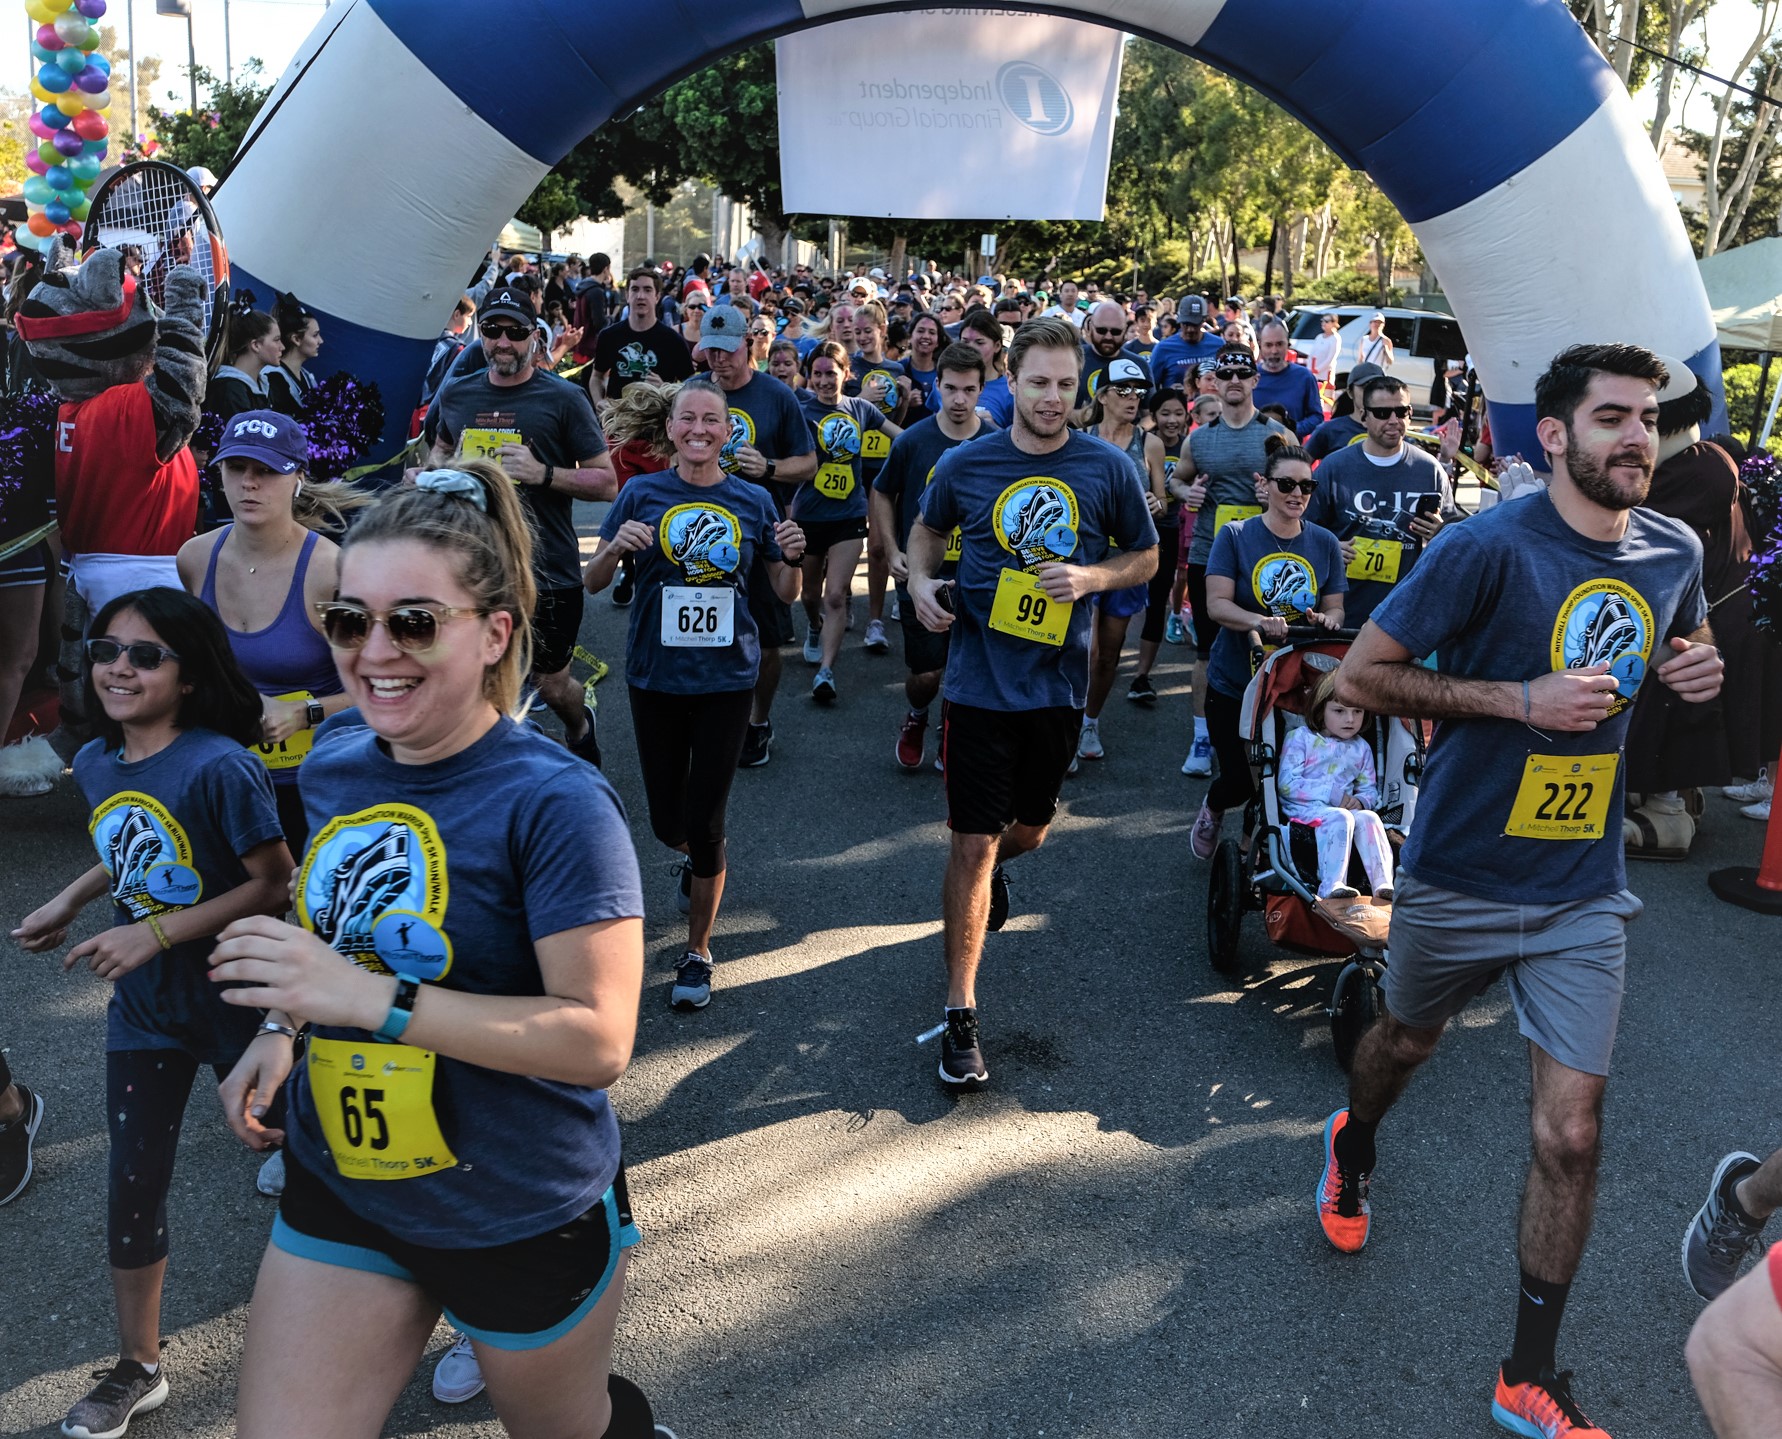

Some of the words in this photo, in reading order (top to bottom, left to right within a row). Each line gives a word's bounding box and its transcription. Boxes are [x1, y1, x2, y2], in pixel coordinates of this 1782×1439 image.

[56, 420, 76, 453] E
[233, 419, 278, 439] TCU
[867, 436, 880, 450] 27
[823, 473, 847, 491] 250
[1365, 552, 1384, 572] 70
[678, 606, 717, 633] 626
[1016, 594, 1047, 625] 99
[1027, 628, 1046, 638] Thorp
[1047, 632, 1058, 641] 5K
[280, 753, 304, 763] Thorp
[1535, 782, 1594, 820] 222
[1560, 825, 1582, 834] Thorp
[1583, 823, 1596, 833] 5K
[340, 1086, 389, 1150] 65
[370, 1158, 409, 1171] Thorp
[413, 1156, 438, 1169] 5K
